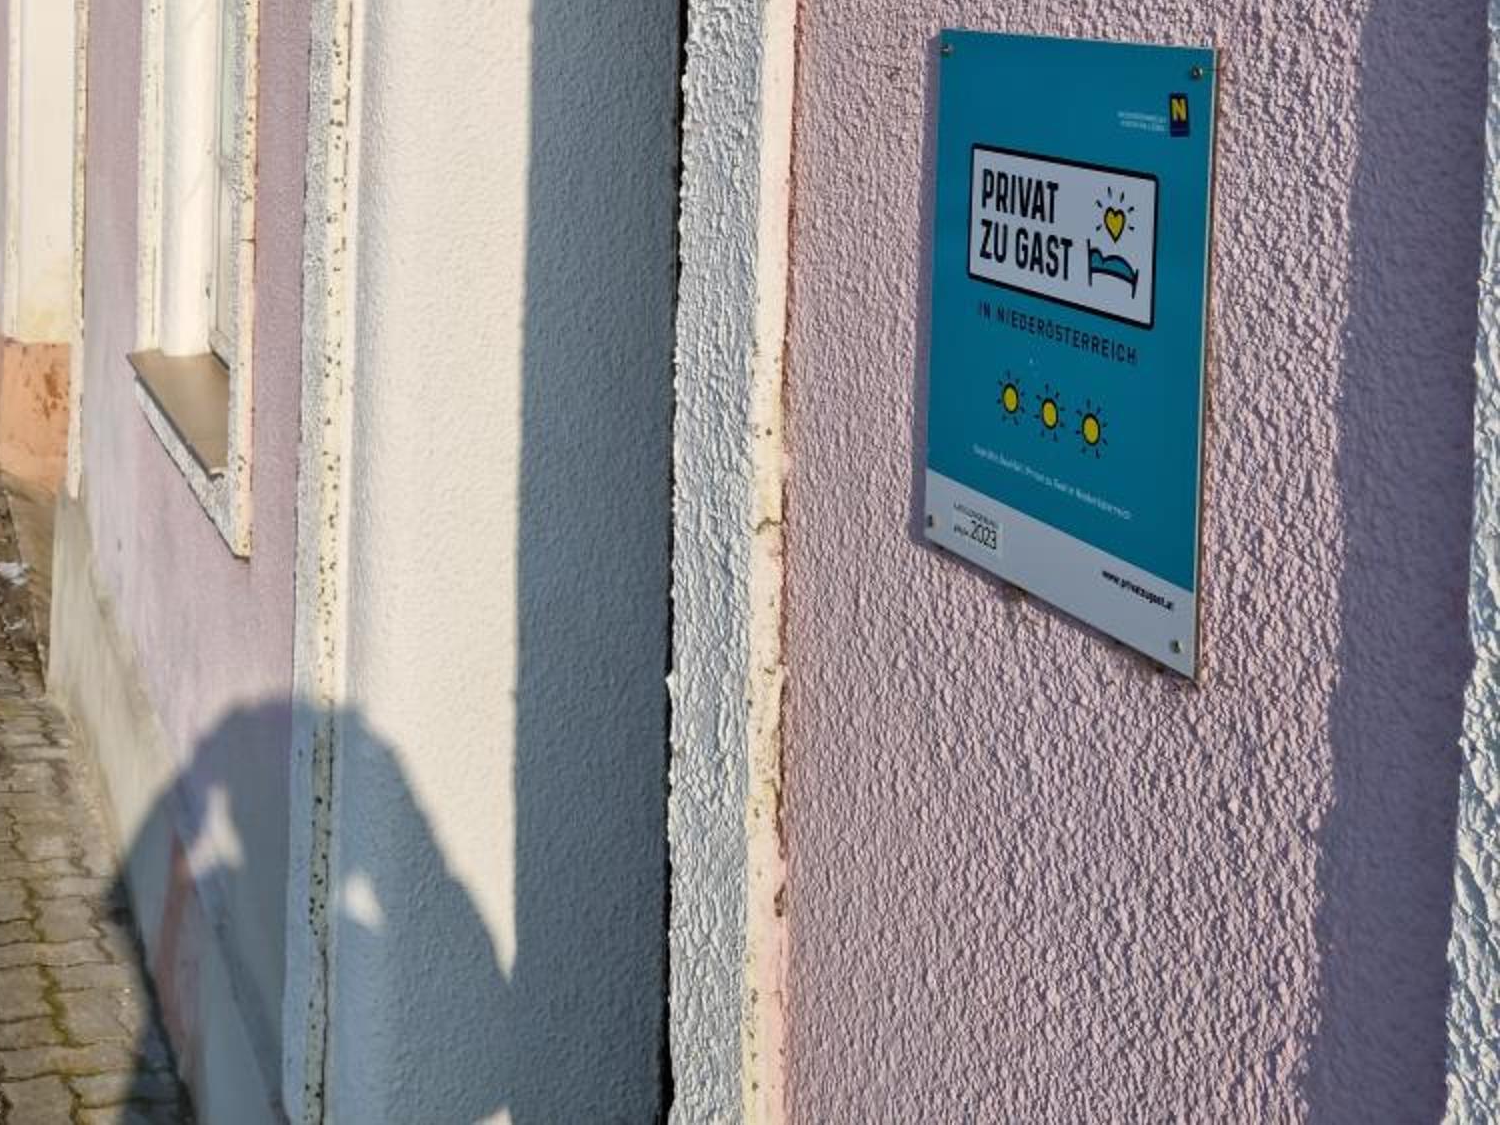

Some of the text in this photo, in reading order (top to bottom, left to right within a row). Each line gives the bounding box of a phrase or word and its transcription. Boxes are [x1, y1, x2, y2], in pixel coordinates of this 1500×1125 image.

[981, 168, 1059, 224] PRIVAT
[980, 219, 1073, 281] ZU GAST
[979, 300, 1138, 364] IN NIEDERÖSTERREICH
[970, 520, 997, 550] 2023
